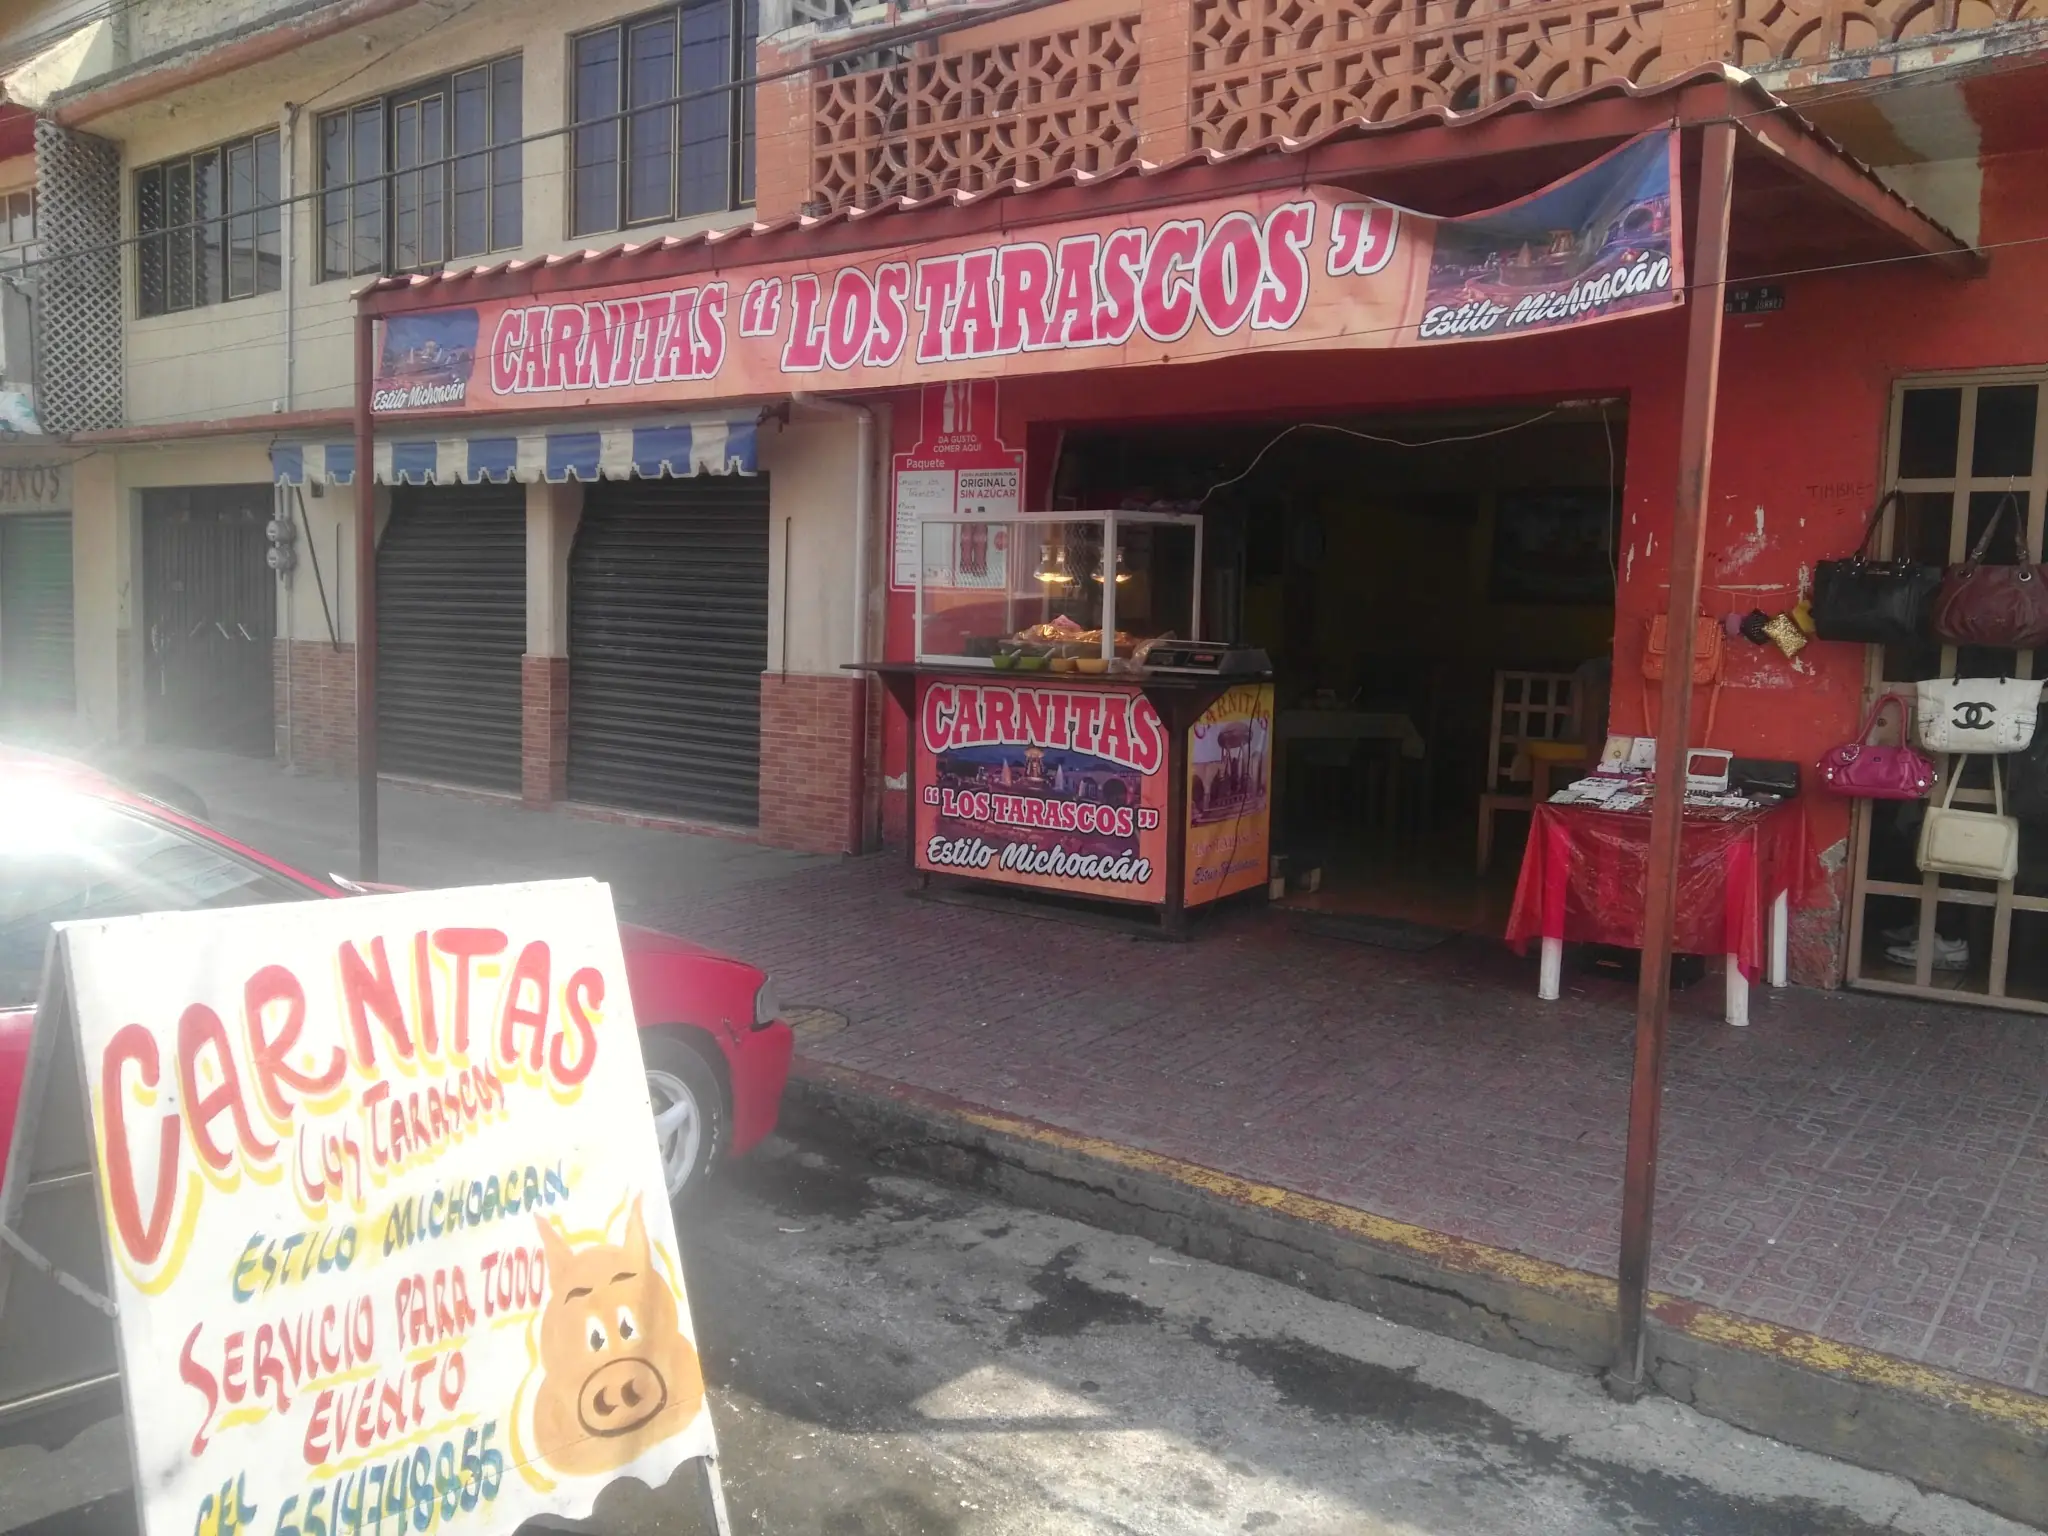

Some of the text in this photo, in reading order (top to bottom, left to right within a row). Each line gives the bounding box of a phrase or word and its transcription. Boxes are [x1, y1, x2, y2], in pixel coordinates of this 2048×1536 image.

[1420, 252, 1672, 337] Estilo Michoacán
[491, 281, 729, 395] CARNITAS
[374, 377, 465, 411] Estilo Michoacán
[906, 458, 945, 470] Paquete
[933, 445, 960, 453] COMER
[951, 434, 977, 443] GUSTO
[960, 478, 1017, 488] ORIGINAL O
[960, 490, 975, 498] SIN
[923, 682, 1162, 775] CARNITAS
[926, 835, 998, 868] Estilo
[1000, 842, 1152, 883] Michoacán
[98, 926, 606, 1275] CARNITAS
[362, 1056, 505, 1170] TARASCOS
[231, 1159, 570, 1304] ESTILO MICHOACAN
[178, 1246, 545, 1458] SERVICIO PARA TODO
[303, 1351, 466, 1466] EVENTO
